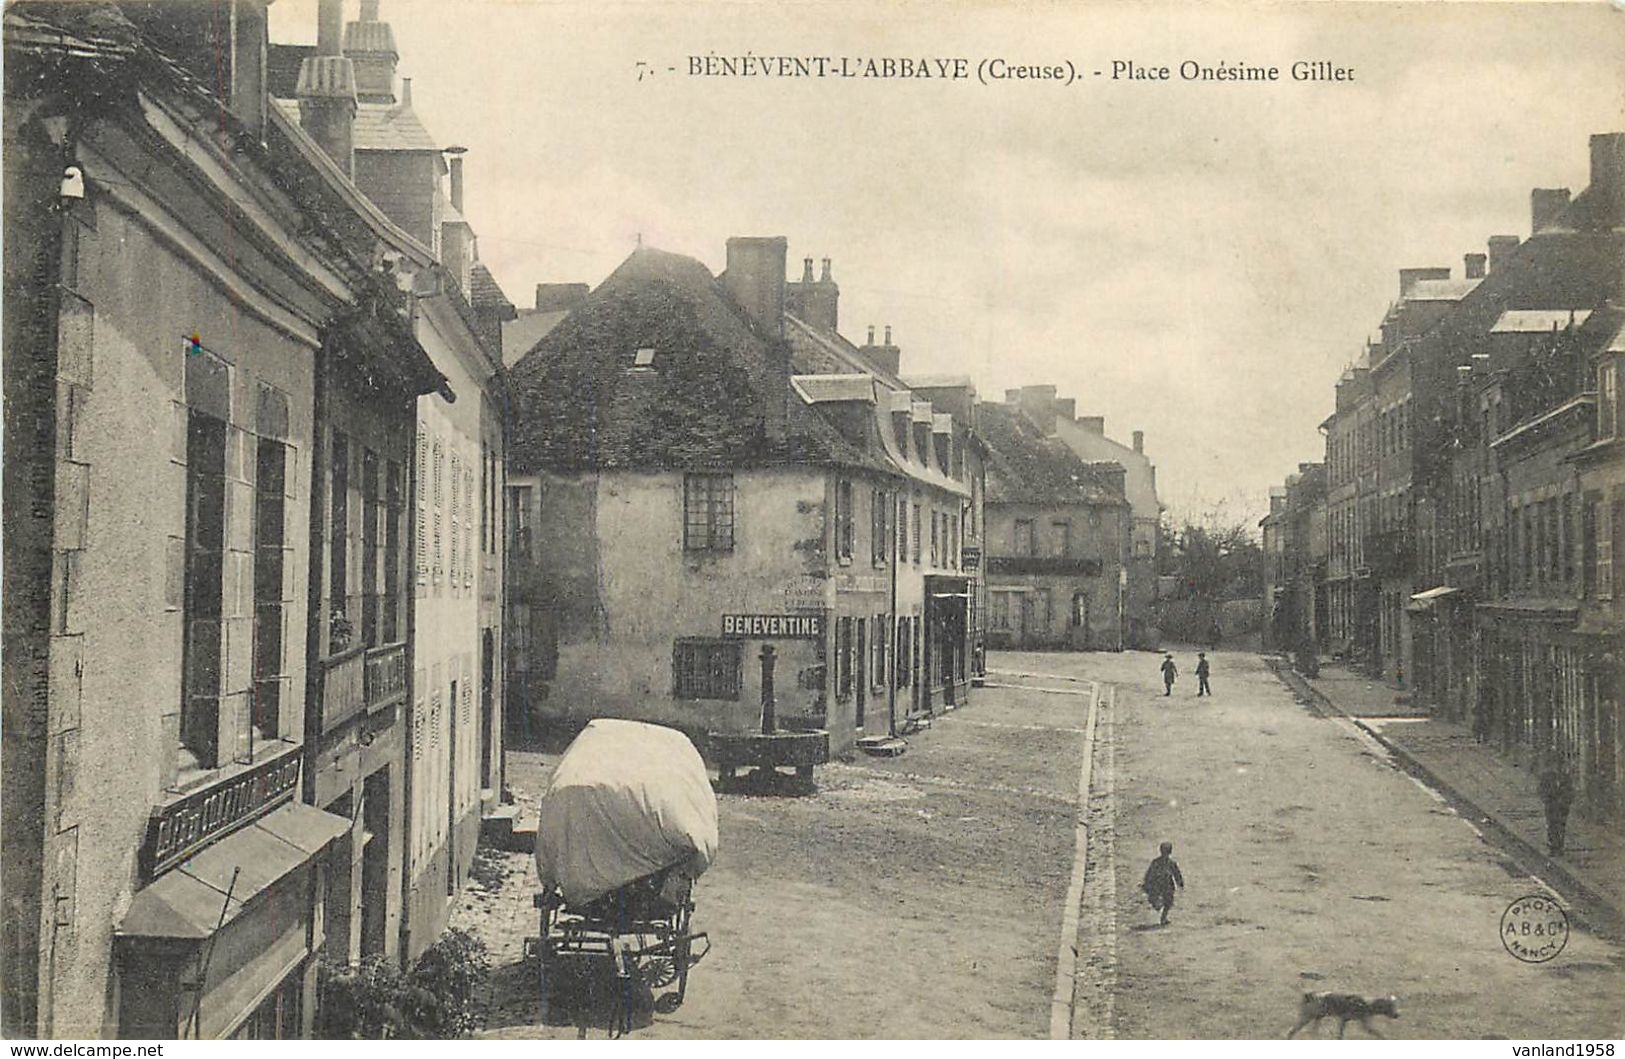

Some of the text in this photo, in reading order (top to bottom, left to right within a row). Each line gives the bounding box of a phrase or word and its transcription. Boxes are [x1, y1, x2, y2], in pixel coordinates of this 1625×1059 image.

[636, 62, 654, 82] 7.
[977, 58, 1082, 86] (Creuse).
[1111, 60, 1170, 81] Place
[1179, 60, 1279, 81] Onésime
[1291, 61, 1355, 81] Gillet
[1511, 940, 1556, 957] NANCY
